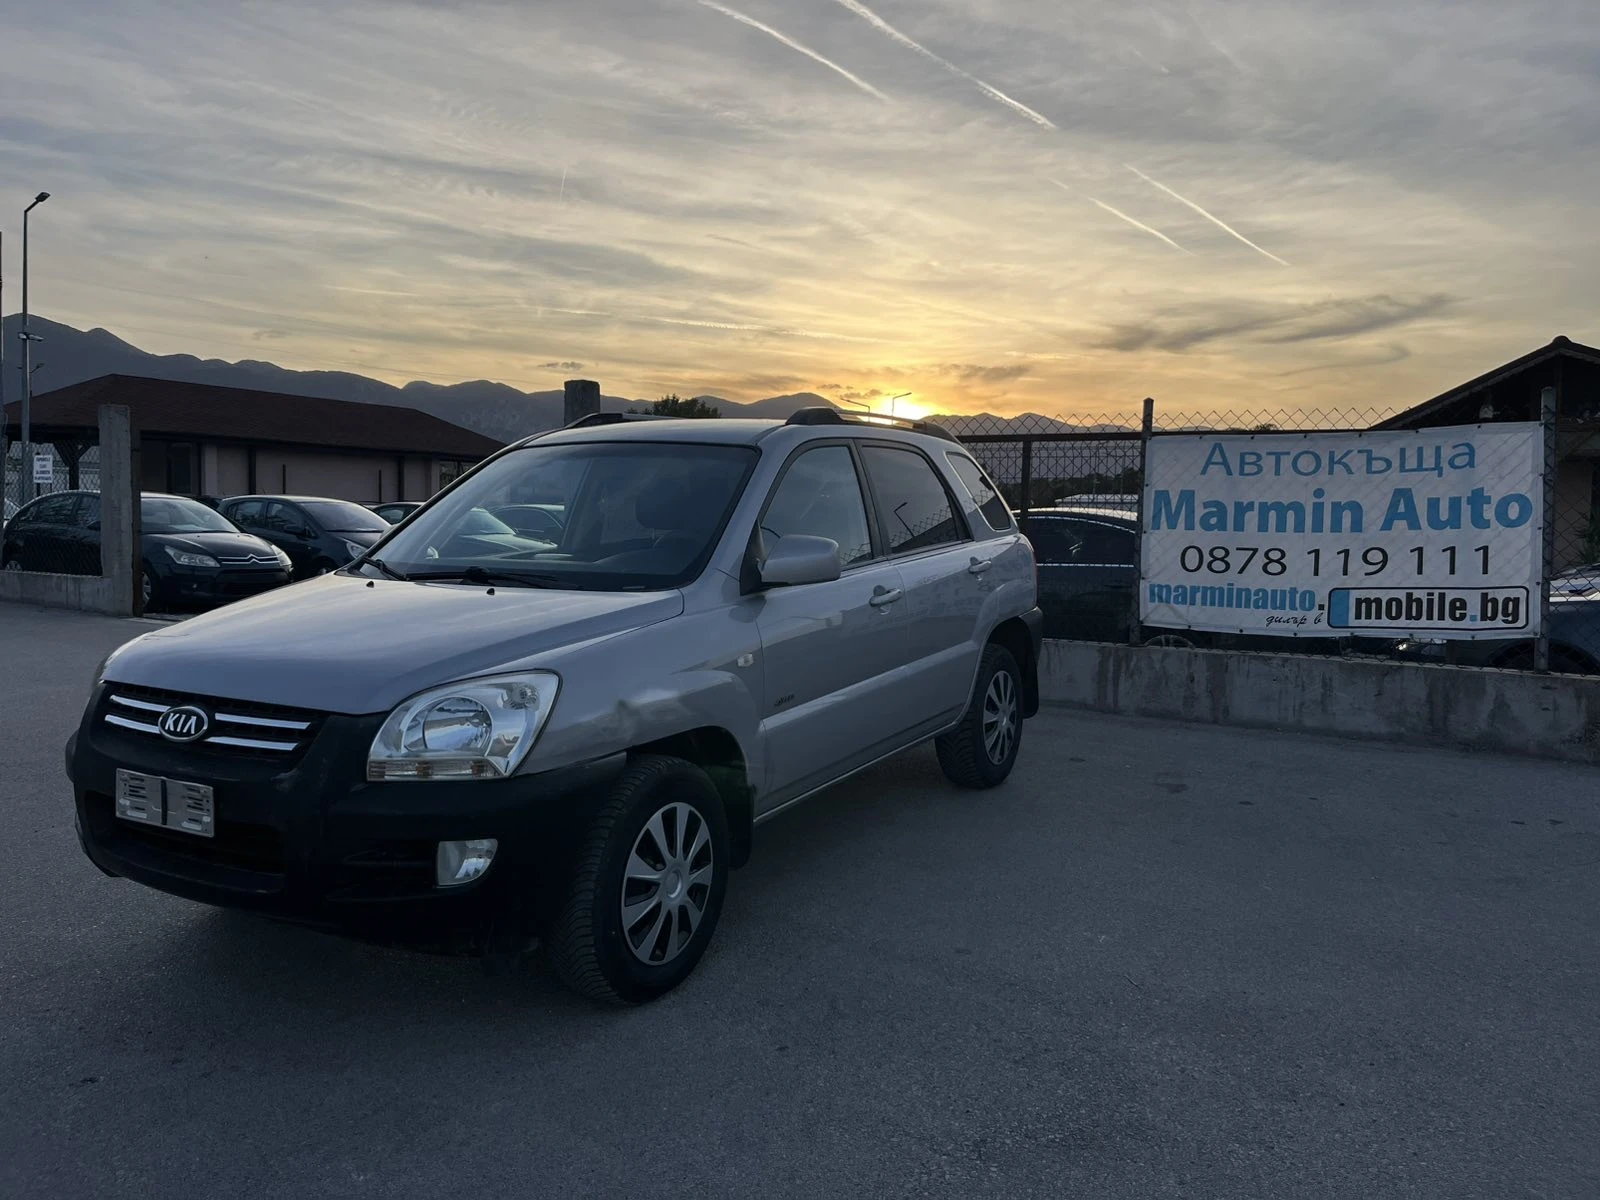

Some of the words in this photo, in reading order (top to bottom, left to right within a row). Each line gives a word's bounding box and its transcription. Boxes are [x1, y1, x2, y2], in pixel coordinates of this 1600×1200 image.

[1200, 442, 1476, 477] Автокъща
[1151, 487, 1364, 533] Marmin
[1380, 487, 1533, 532] Auto
[1179, 544, 1288, 576] 0878
[1307, 545, 1389, 577] 119
[1409, 544, 1490, 575] 111
[1354, 592, 1521, 625] mobile.bg
[165, 713, 197, 735] KIA
